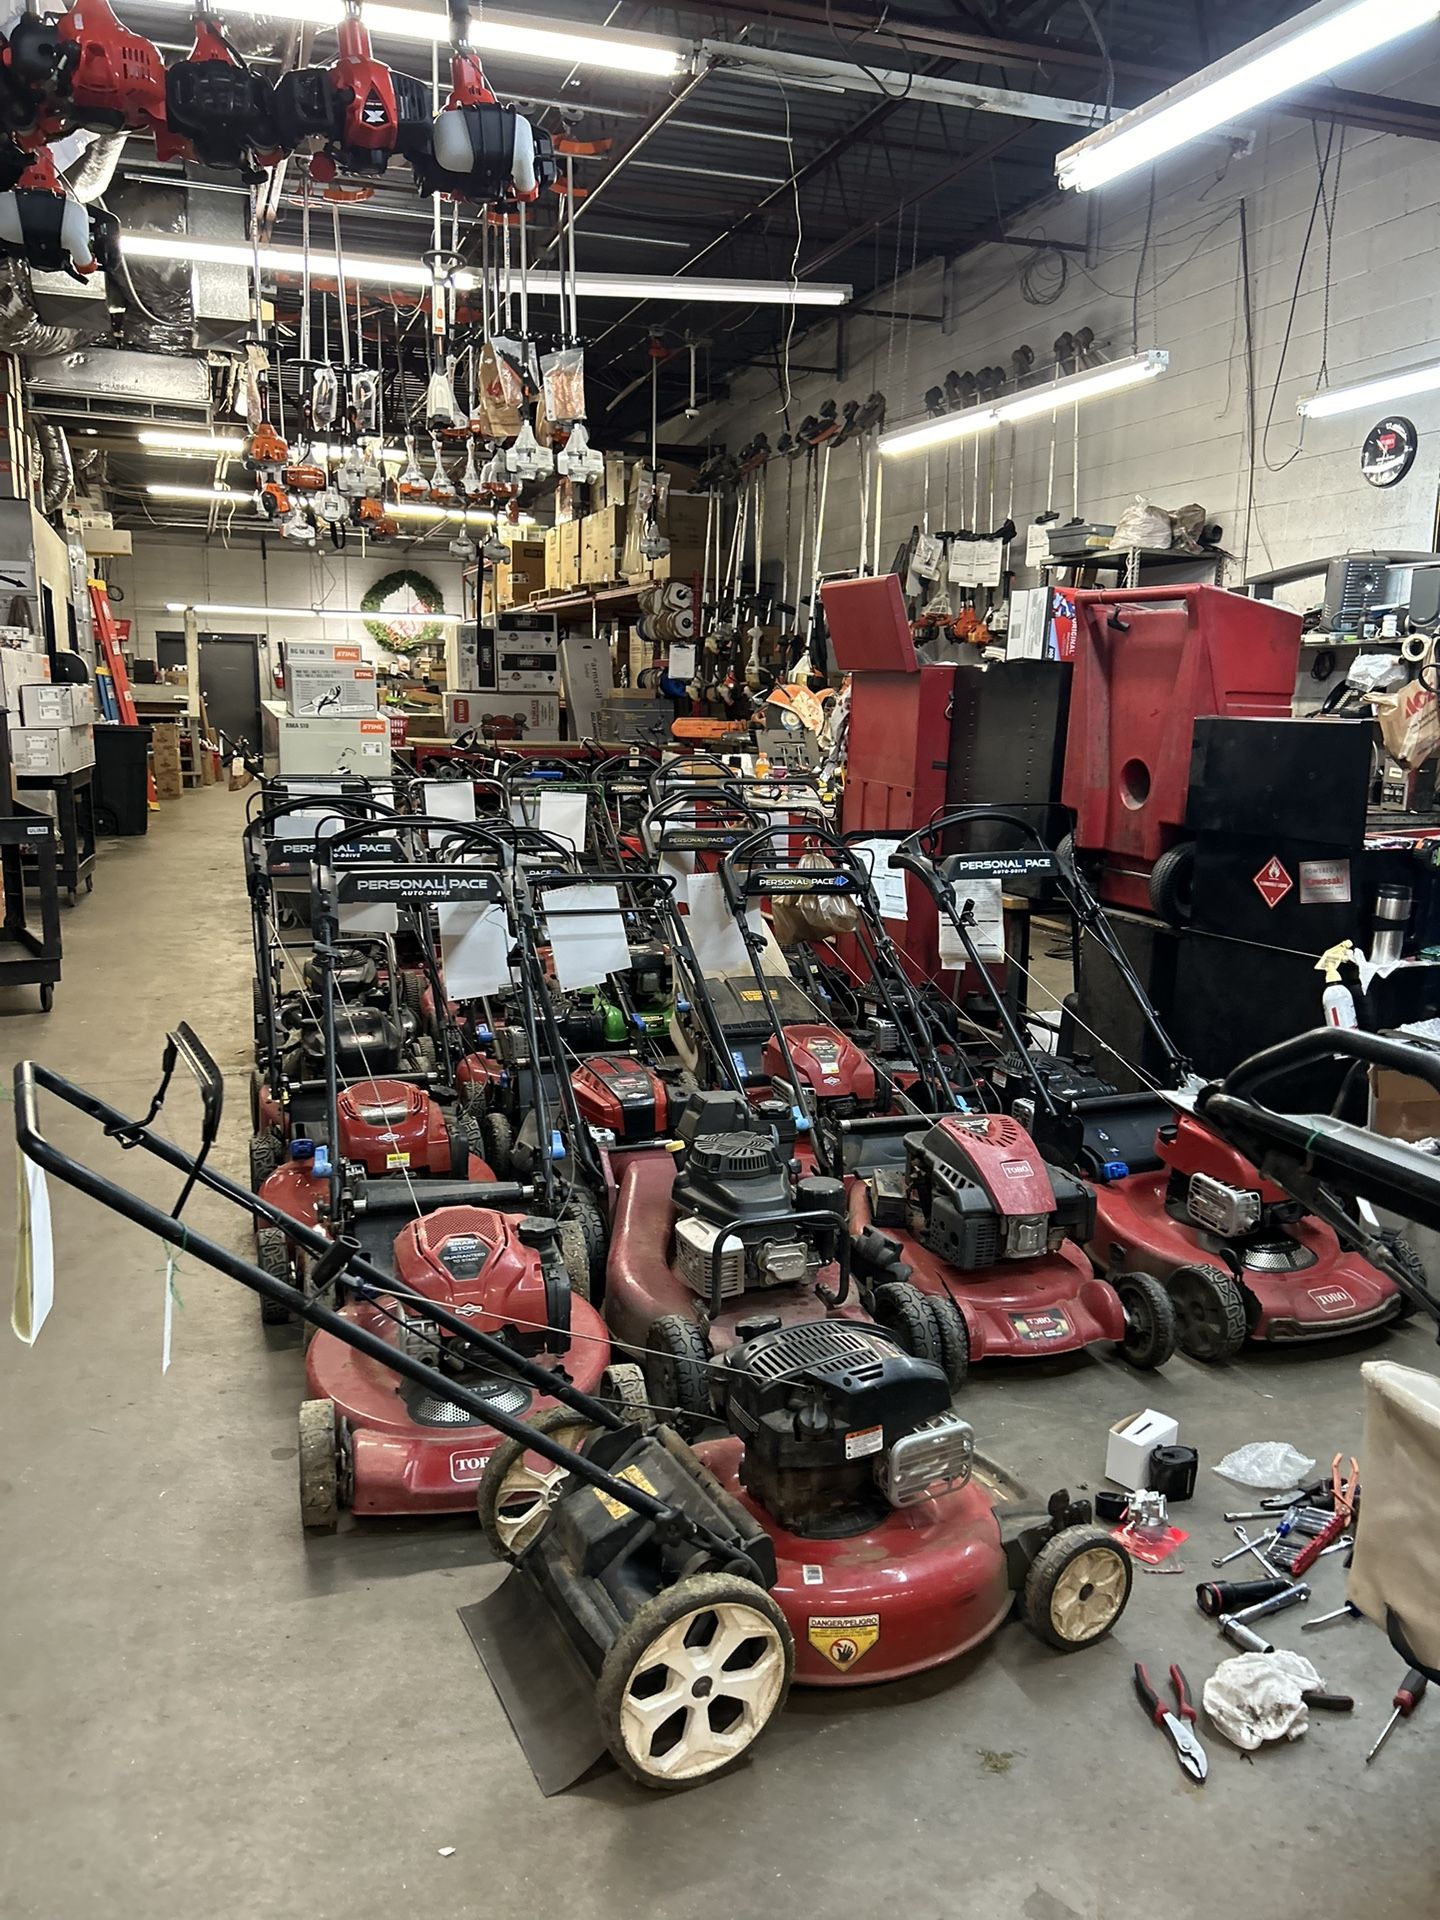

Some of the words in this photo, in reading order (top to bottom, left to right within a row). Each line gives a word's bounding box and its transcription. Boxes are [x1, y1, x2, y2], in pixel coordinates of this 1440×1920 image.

[336, 650, 358, 658] STIHL
[283, 844, 355, 853] PERSAL
[360, 844, 391, 852] PACE
[960, 859, 1022, 870] PERSONAL
[1025, 859, 1051, 868] PACE
[357, 879, 443, 890] PERSONAL
[449, 879, 489, 889] PACE
[760, 878, 808, 886] PERSONAL
[1006, 1165, 1028, 1174] TORO
[1316, 1291, 1347, 1305] TORO
[811, 1617, 877, 1627] DANGER/PELIGRO
